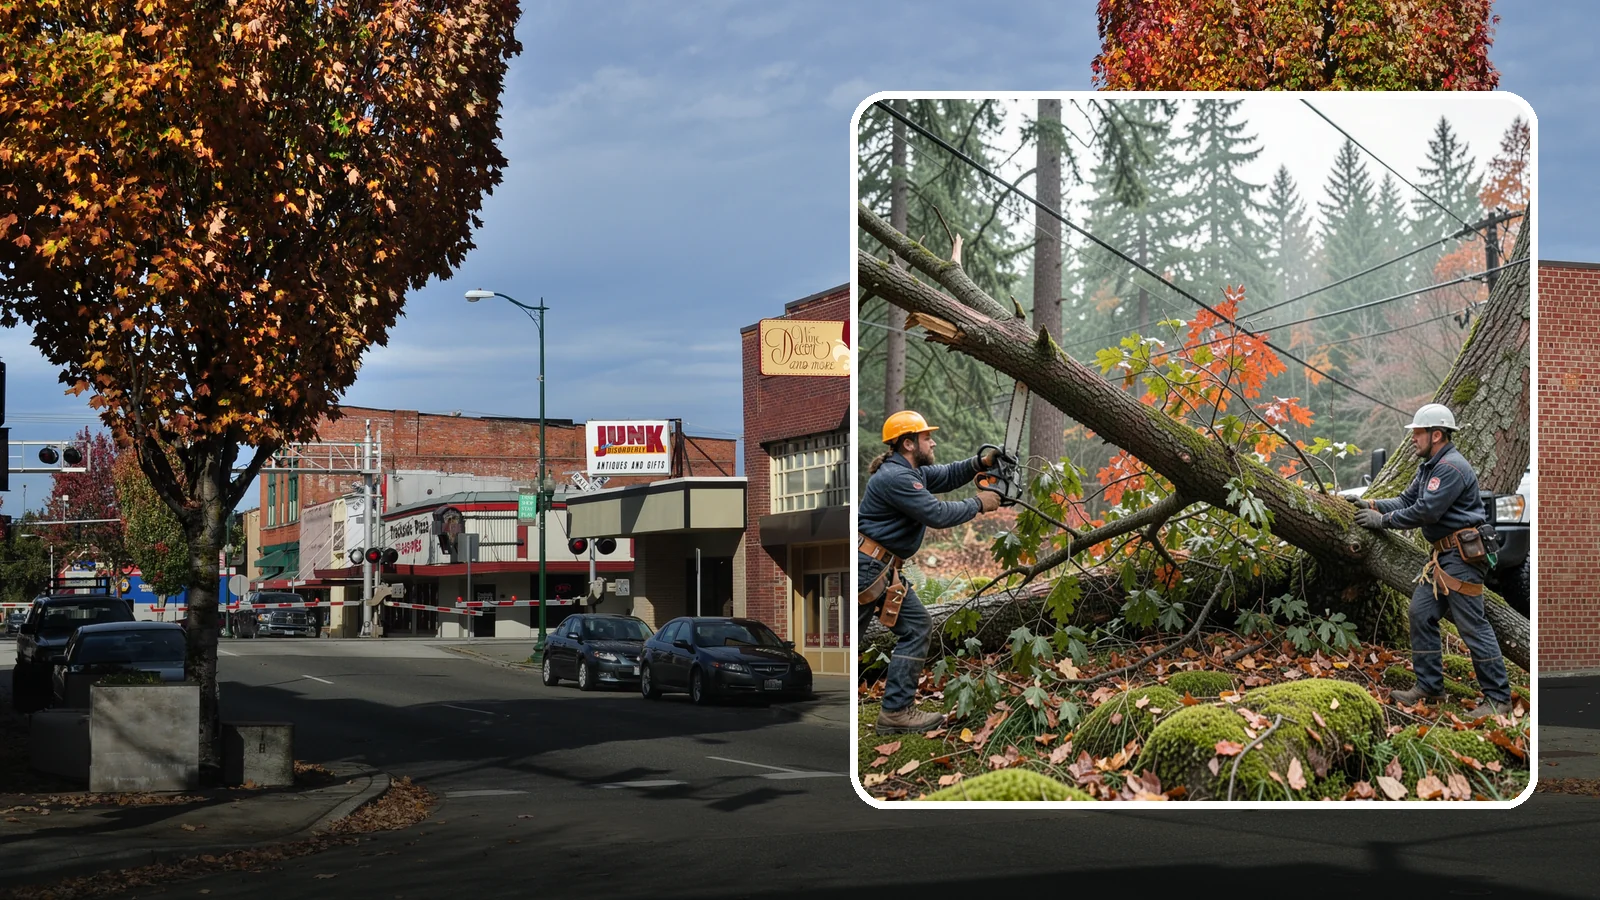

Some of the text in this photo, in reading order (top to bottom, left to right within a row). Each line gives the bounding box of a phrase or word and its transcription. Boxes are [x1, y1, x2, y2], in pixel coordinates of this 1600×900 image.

[765, 328, 830, 366] Decor
[595, 425, 665, 457] JUNK
[607, 446, 646, 454] DISORDERLY
[597, 460, 665, 470] ANTIQUES AND GIFTS
[590, 476, 608, 492] SING
[390, 519, 429, 540] Trackside Pizza
